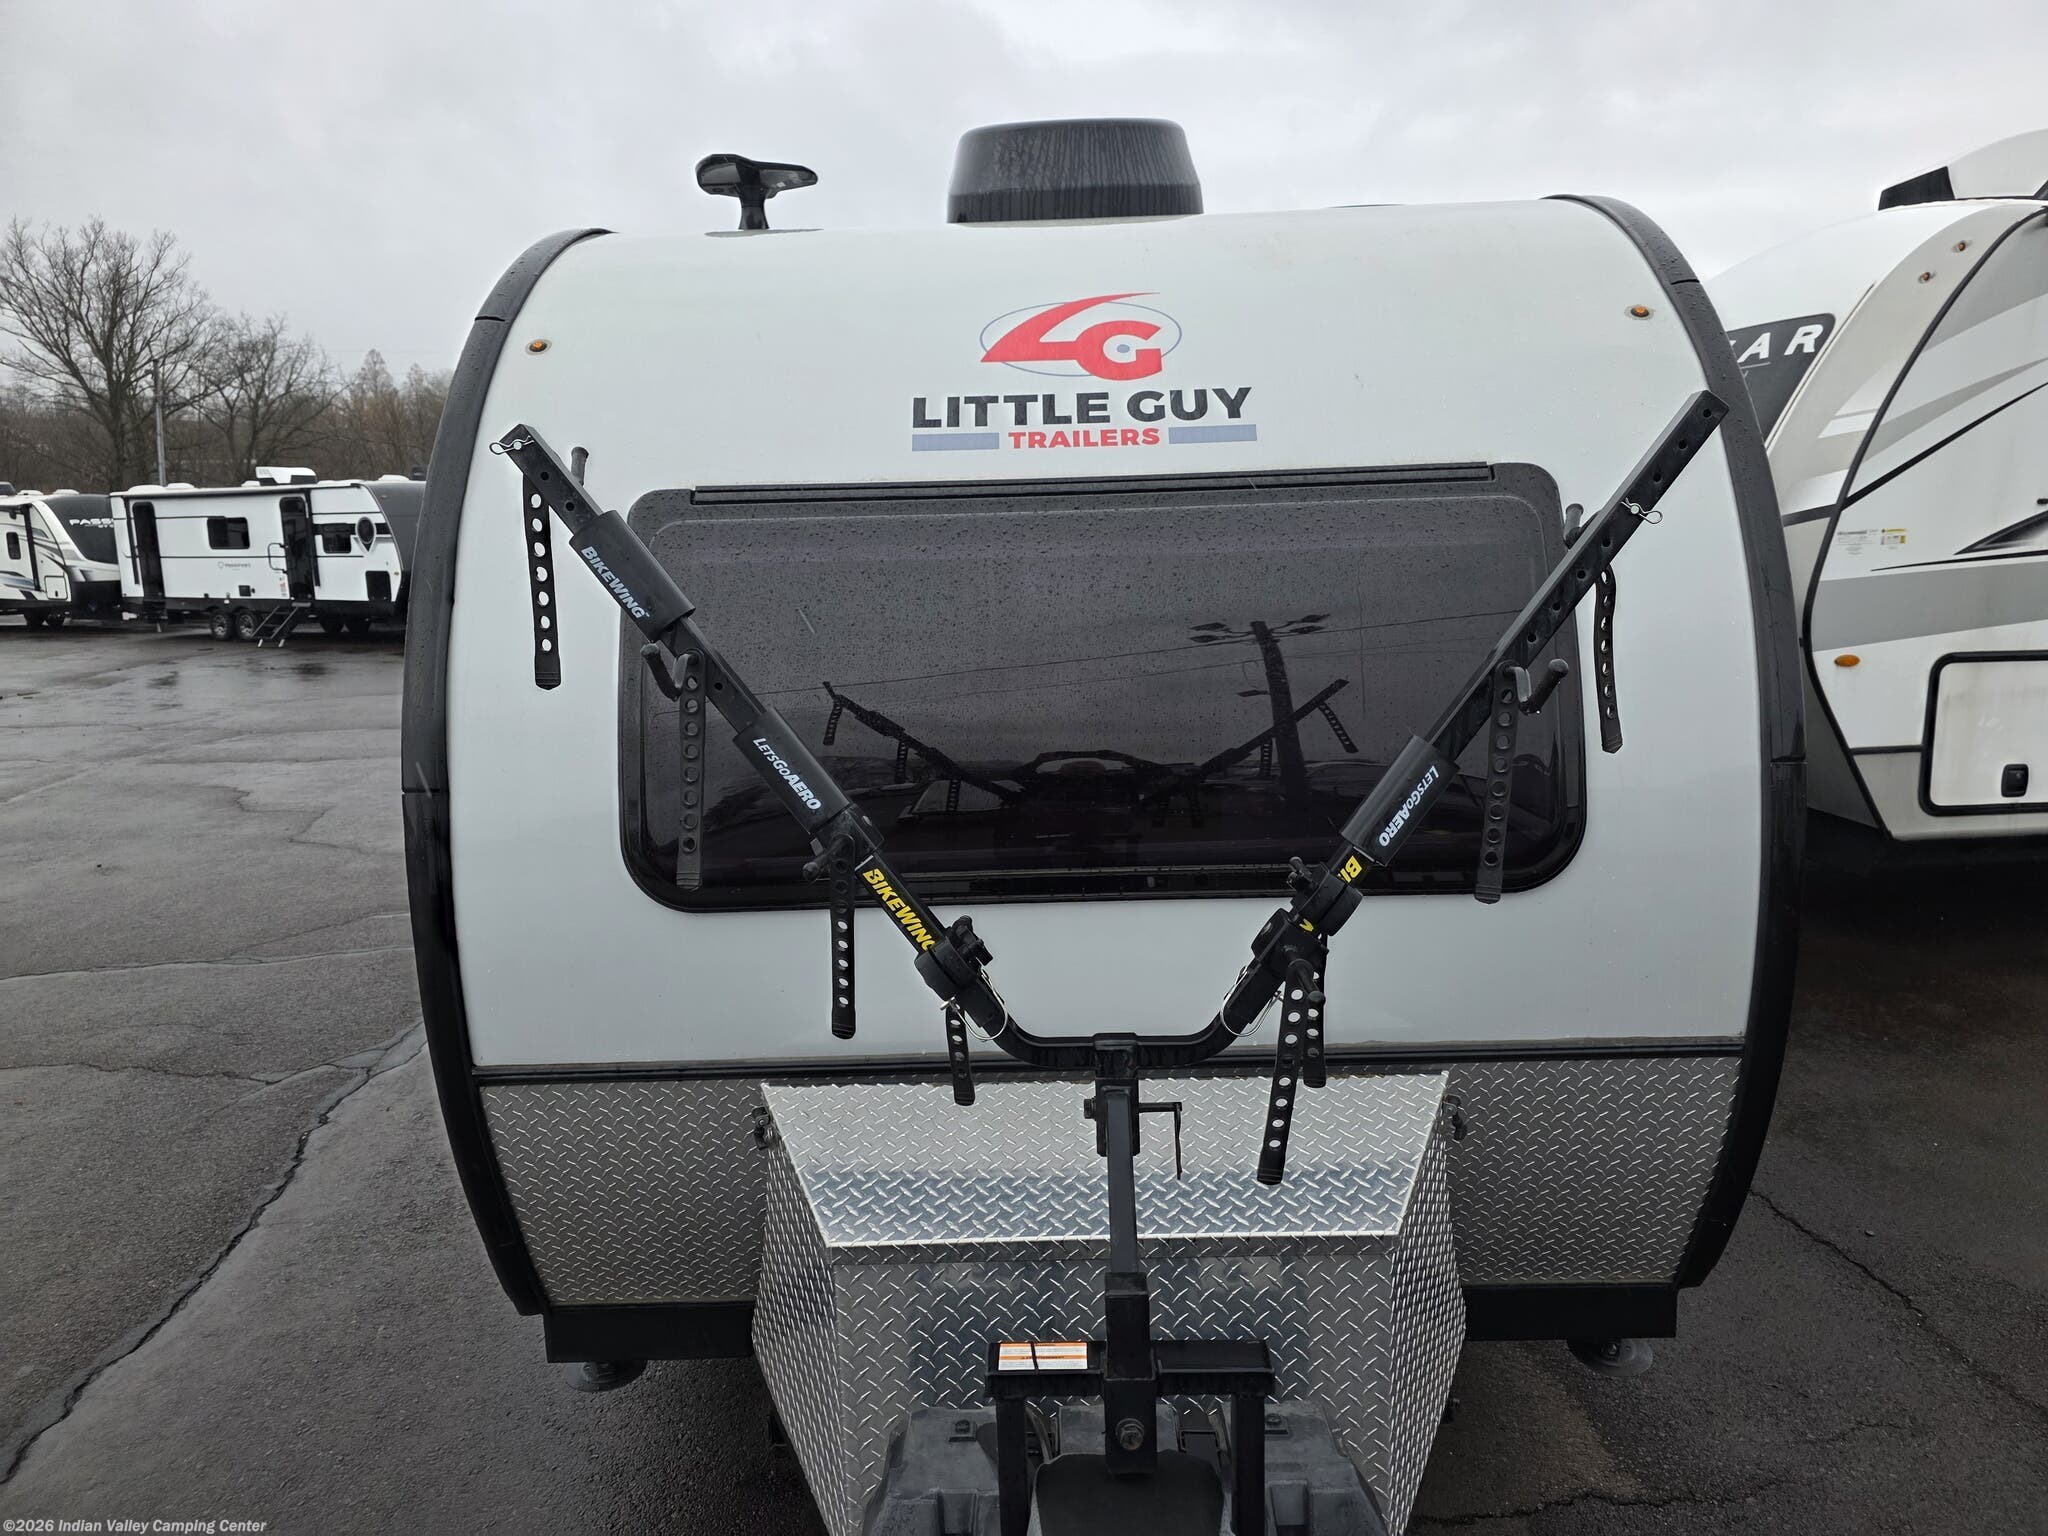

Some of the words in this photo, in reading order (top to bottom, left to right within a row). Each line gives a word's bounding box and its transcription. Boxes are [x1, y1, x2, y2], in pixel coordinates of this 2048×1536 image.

[1729, 324, 1824, 363] AR
[912, 391, 1111, 428] LITTLE
[1126, 386, 1252, 423] GUY
[1008, 427, 1160, 449] TRAILERS
[69, 518, 114, 526] PASS
[581, 546, 646, 619] BIKEWING
